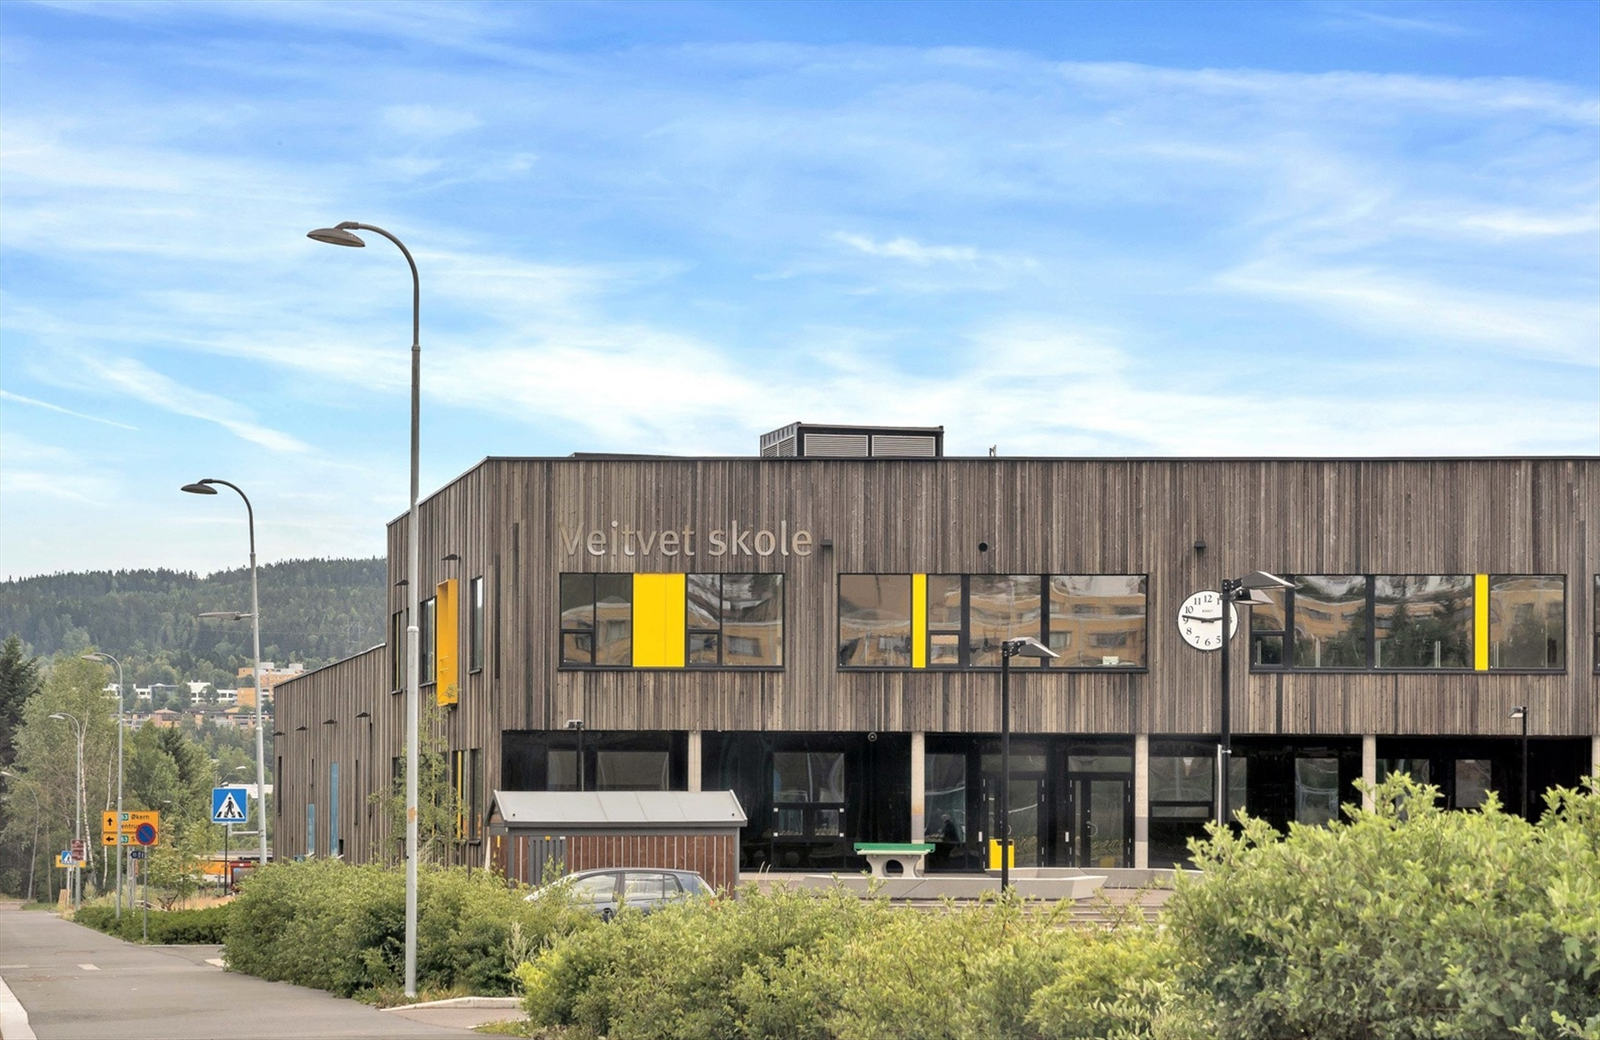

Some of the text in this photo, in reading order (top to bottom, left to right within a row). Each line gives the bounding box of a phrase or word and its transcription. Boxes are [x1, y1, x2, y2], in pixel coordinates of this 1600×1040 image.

[558, 520, 813, 556] Veitvet skole
[1204, 595, 1212, 603] 12
[1185, 606, 1194, 614] 10
[1182, 616, 1189, 624] 9
[1186, 627, 1192, 635] 8
[1195, 636, 1200, 644] 7
[1204, 638, 1211, 646] 6
[1216, 636, 1221, 644] 5
